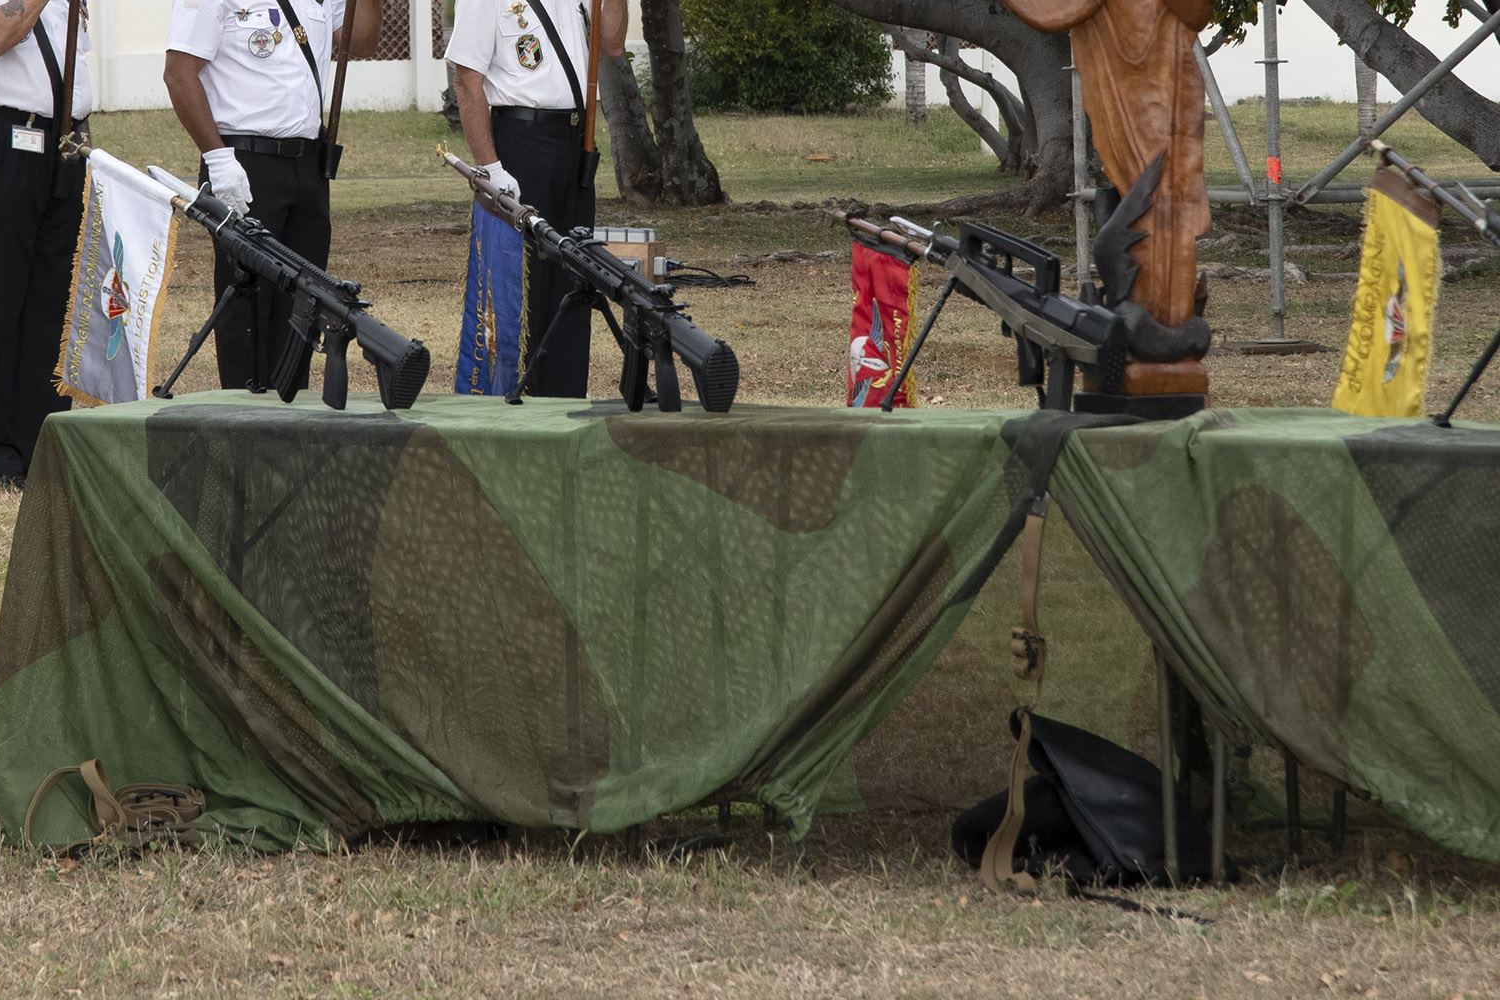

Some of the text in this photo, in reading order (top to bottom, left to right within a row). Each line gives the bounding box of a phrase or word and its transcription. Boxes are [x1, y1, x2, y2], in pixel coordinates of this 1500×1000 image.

[69, 179, 105, 385] COMPAGNIE DE COMMANDEMENT
[135, 238, 162, 339] LOGISTIQUE
